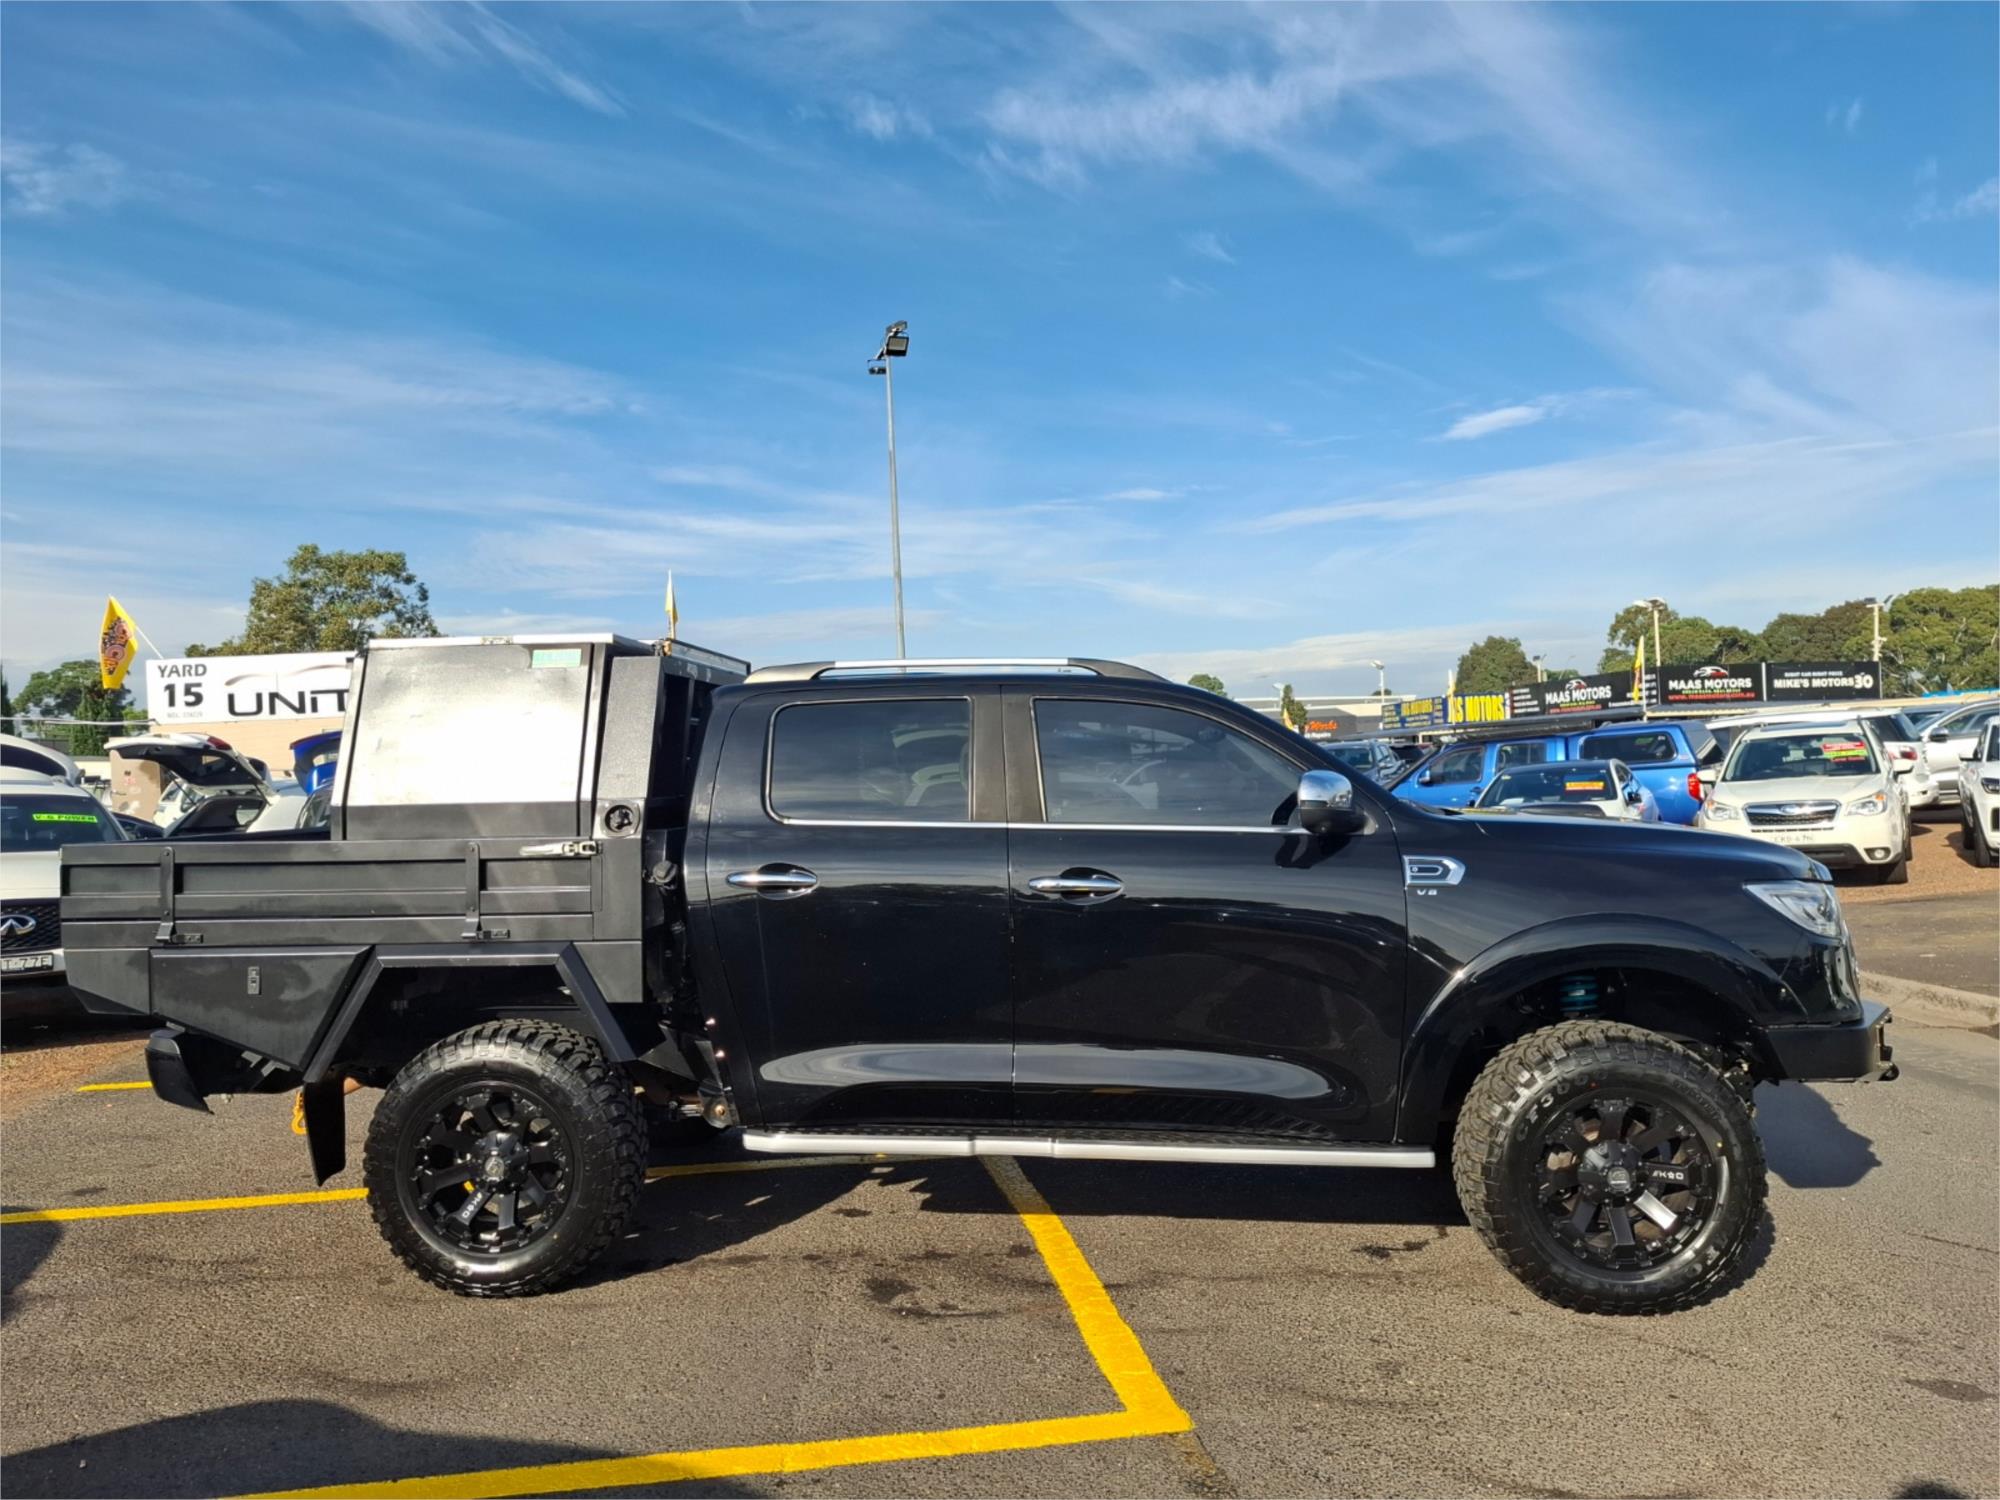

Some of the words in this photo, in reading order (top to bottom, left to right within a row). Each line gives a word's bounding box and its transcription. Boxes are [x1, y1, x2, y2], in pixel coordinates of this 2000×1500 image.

[158, 663, 207, 678] YARD
[1668, 679, 1702, 690] MAAS
[1704, 678, 1752, 689] MOTORS
[1773, 678, 1810, 688] MIKE'S
[1812, 677, 1854, 688] MOTORS
[1854, 674, 1874, 689] 30
[163, 682, 204, 707] 15
[1545, 689, 1570, 704] MAAS
[1572, 685, 1612, 701] MOTORS
[1465, 694, 1505, 722] MOTORS
